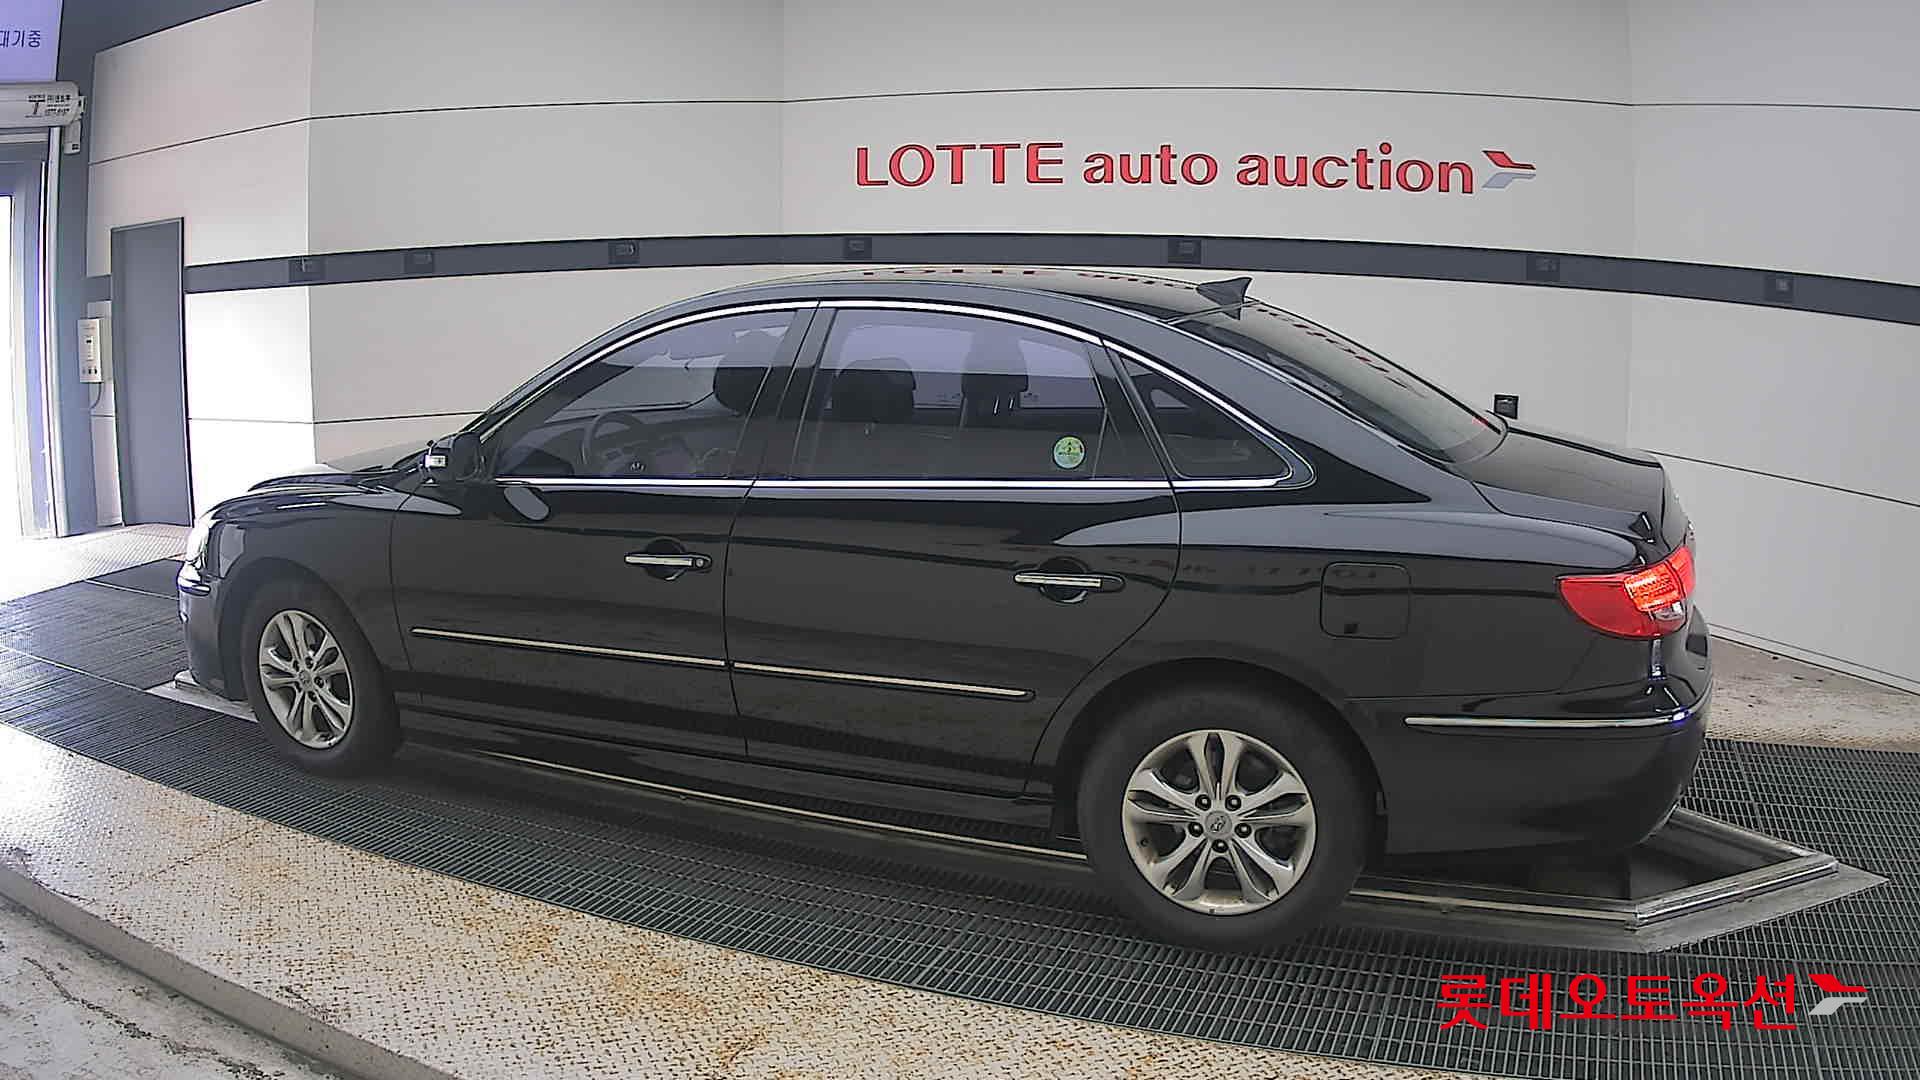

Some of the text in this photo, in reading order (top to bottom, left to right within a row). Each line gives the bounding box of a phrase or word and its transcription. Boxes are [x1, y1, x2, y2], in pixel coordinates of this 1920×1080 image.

[856, 142, 1474, 194] LOTTE auto auction
